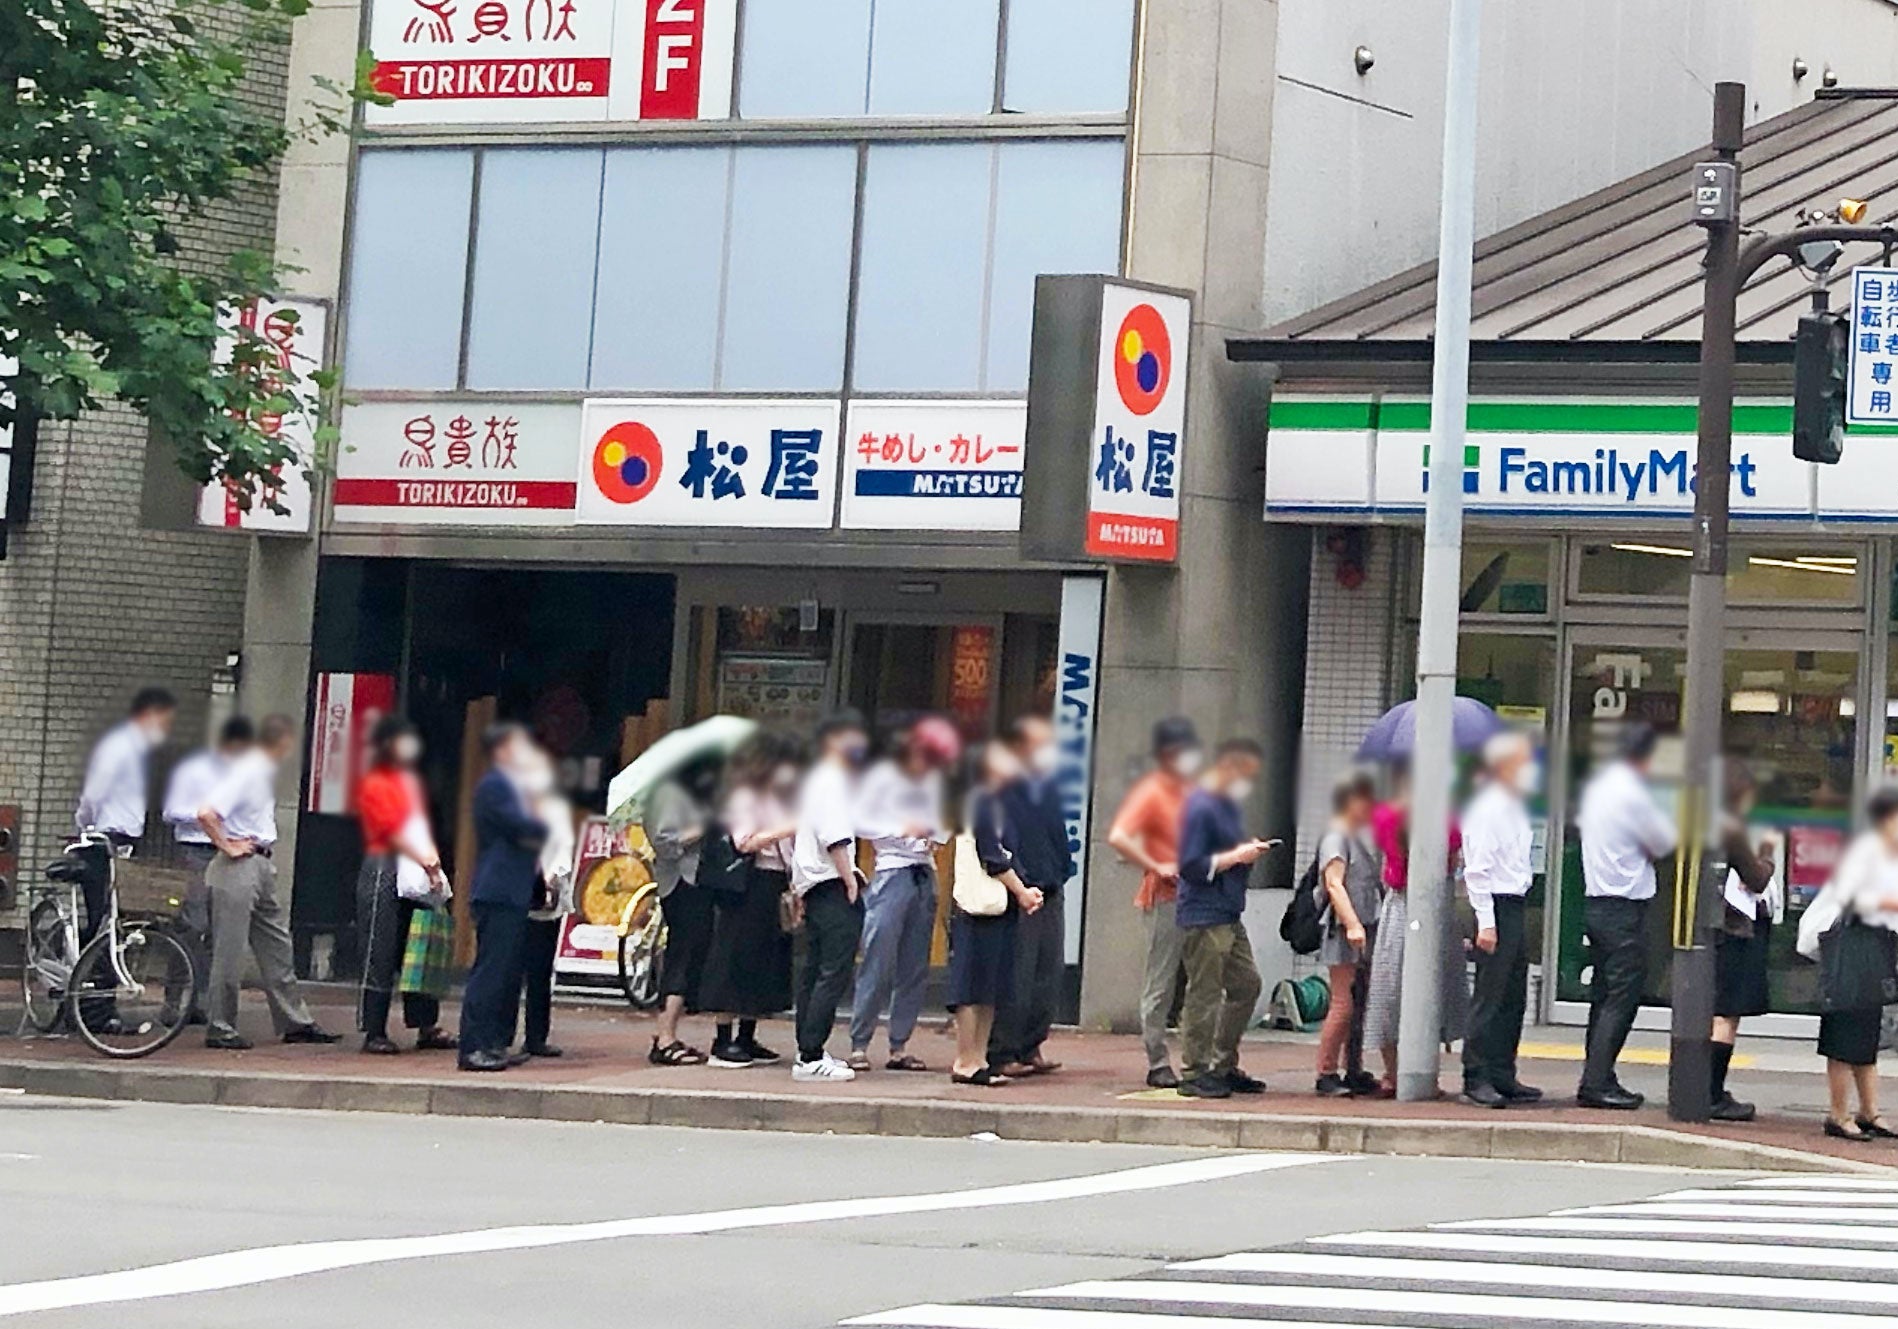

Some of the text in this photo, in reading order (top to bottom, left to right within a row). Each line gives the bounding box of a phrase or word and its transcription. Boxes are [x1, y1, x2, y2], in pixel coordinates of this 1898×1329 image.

[401, 63, 577, 96] TORIKIZOKU
[1858, 278, 1883, 355] 自転車
[1869, 361, 1893, 414] 専用
[400, 414, 520, 470] 鳥貴族
[678, 429, 823, 500] 松屋
[856, 431, 1020, 465] 牛めし・カレー
[1095, 424, 1178, 498] 松屋
[396, 482, 517, 505] TORIKIZOKU
[1499, 447, 1756, 502] FamilyMt
[1100, 522, 1166, 546] MATSUYA
